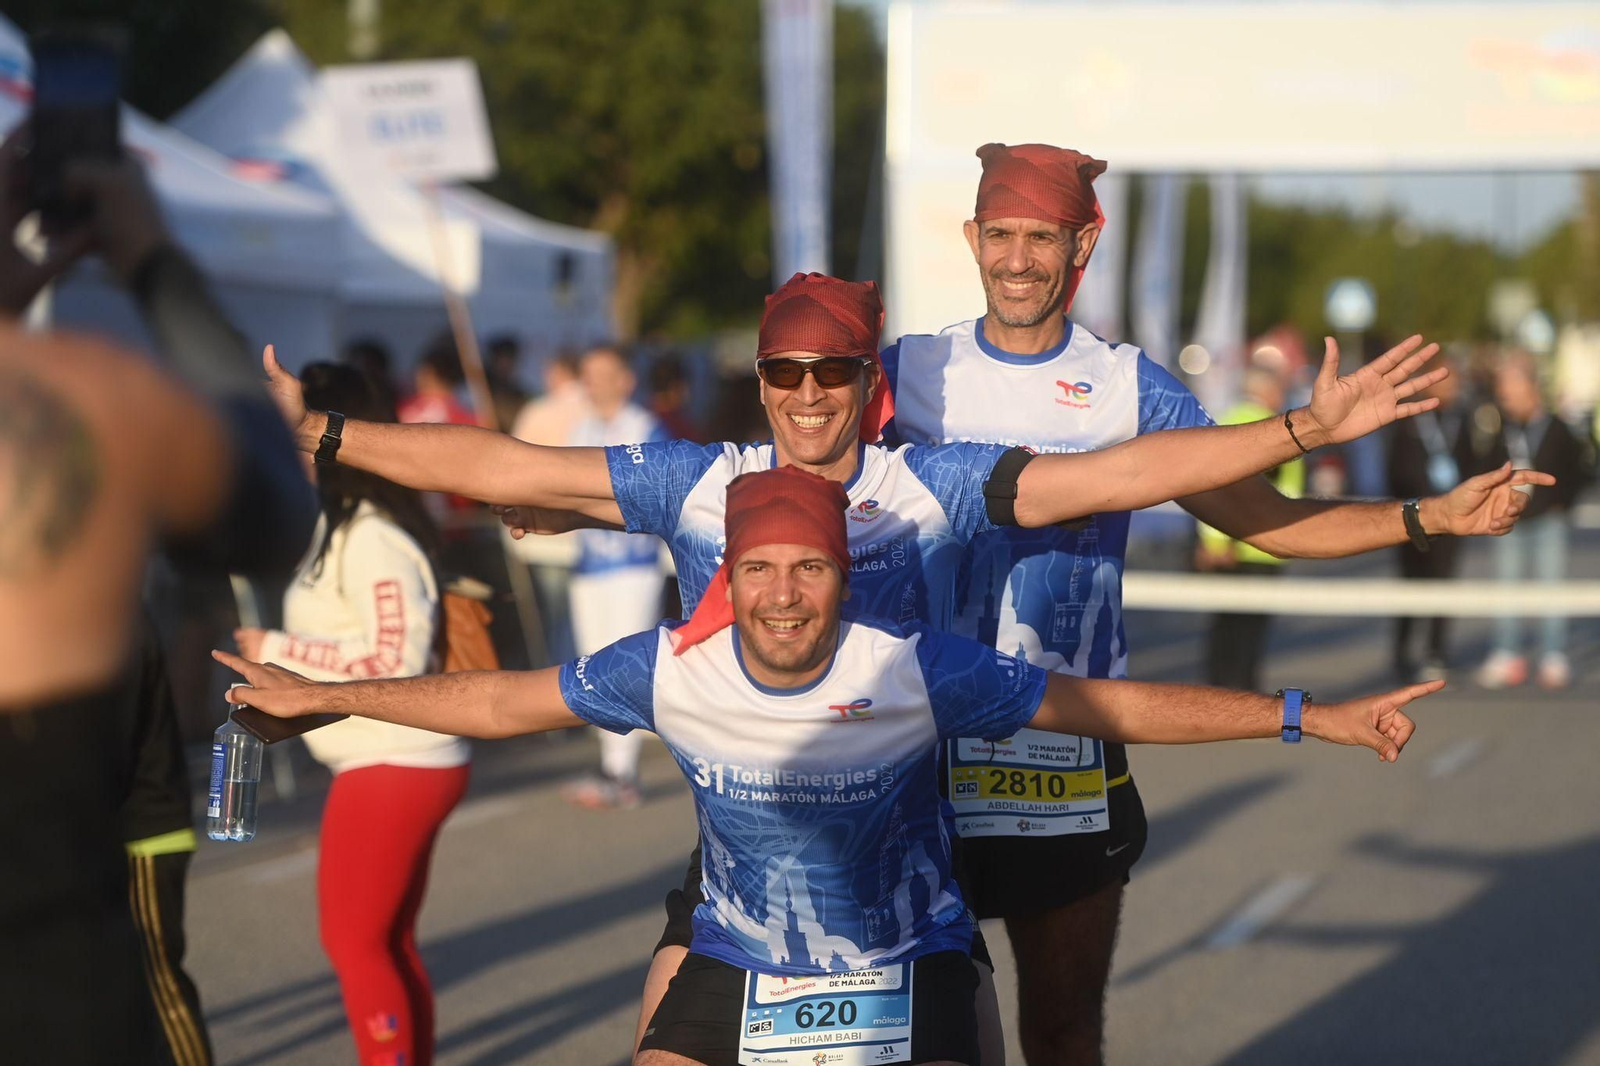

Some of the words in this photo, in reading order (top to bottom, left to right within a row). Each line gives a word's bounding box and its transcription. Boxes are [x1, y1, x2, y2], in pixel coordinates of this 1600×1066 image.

[970, 746, 1017, 756] TotalEergies
[1040, 745, 1076, 753] MARATÓN
[1028, 752, 1039, 760] DE
[1039, 753, 1071, 762] MÁLAGA
[692, 757, 724, 794] 31
[728, 765, 877, 790] TotalEnergies
[880, 763, 894, 795] 2022
[989, 769, 1066, 799] 2810
[729, 788, 747, 800] 1/2
[751, 791, 816, 804] MARATÓN
[820, 789, 877, 804] MÁLAGA
[987, 802, 1042, 812] ABDELLAH
[1045, 803, 1069, 812] HARI
[843, 970, 883, 979] MARATÓN
[769, 981, 817, 997] TotalEnergies
[829, 980, 840, 988] DE
[841, 978, 876, 987] MÁLAGA
[878, 977, 898, 985] 2022
[795, 1000, 857, 1029] 620
[789, 1033, 833, 1045] HICHAM
[836, 1032, 862, 1042] BABI
